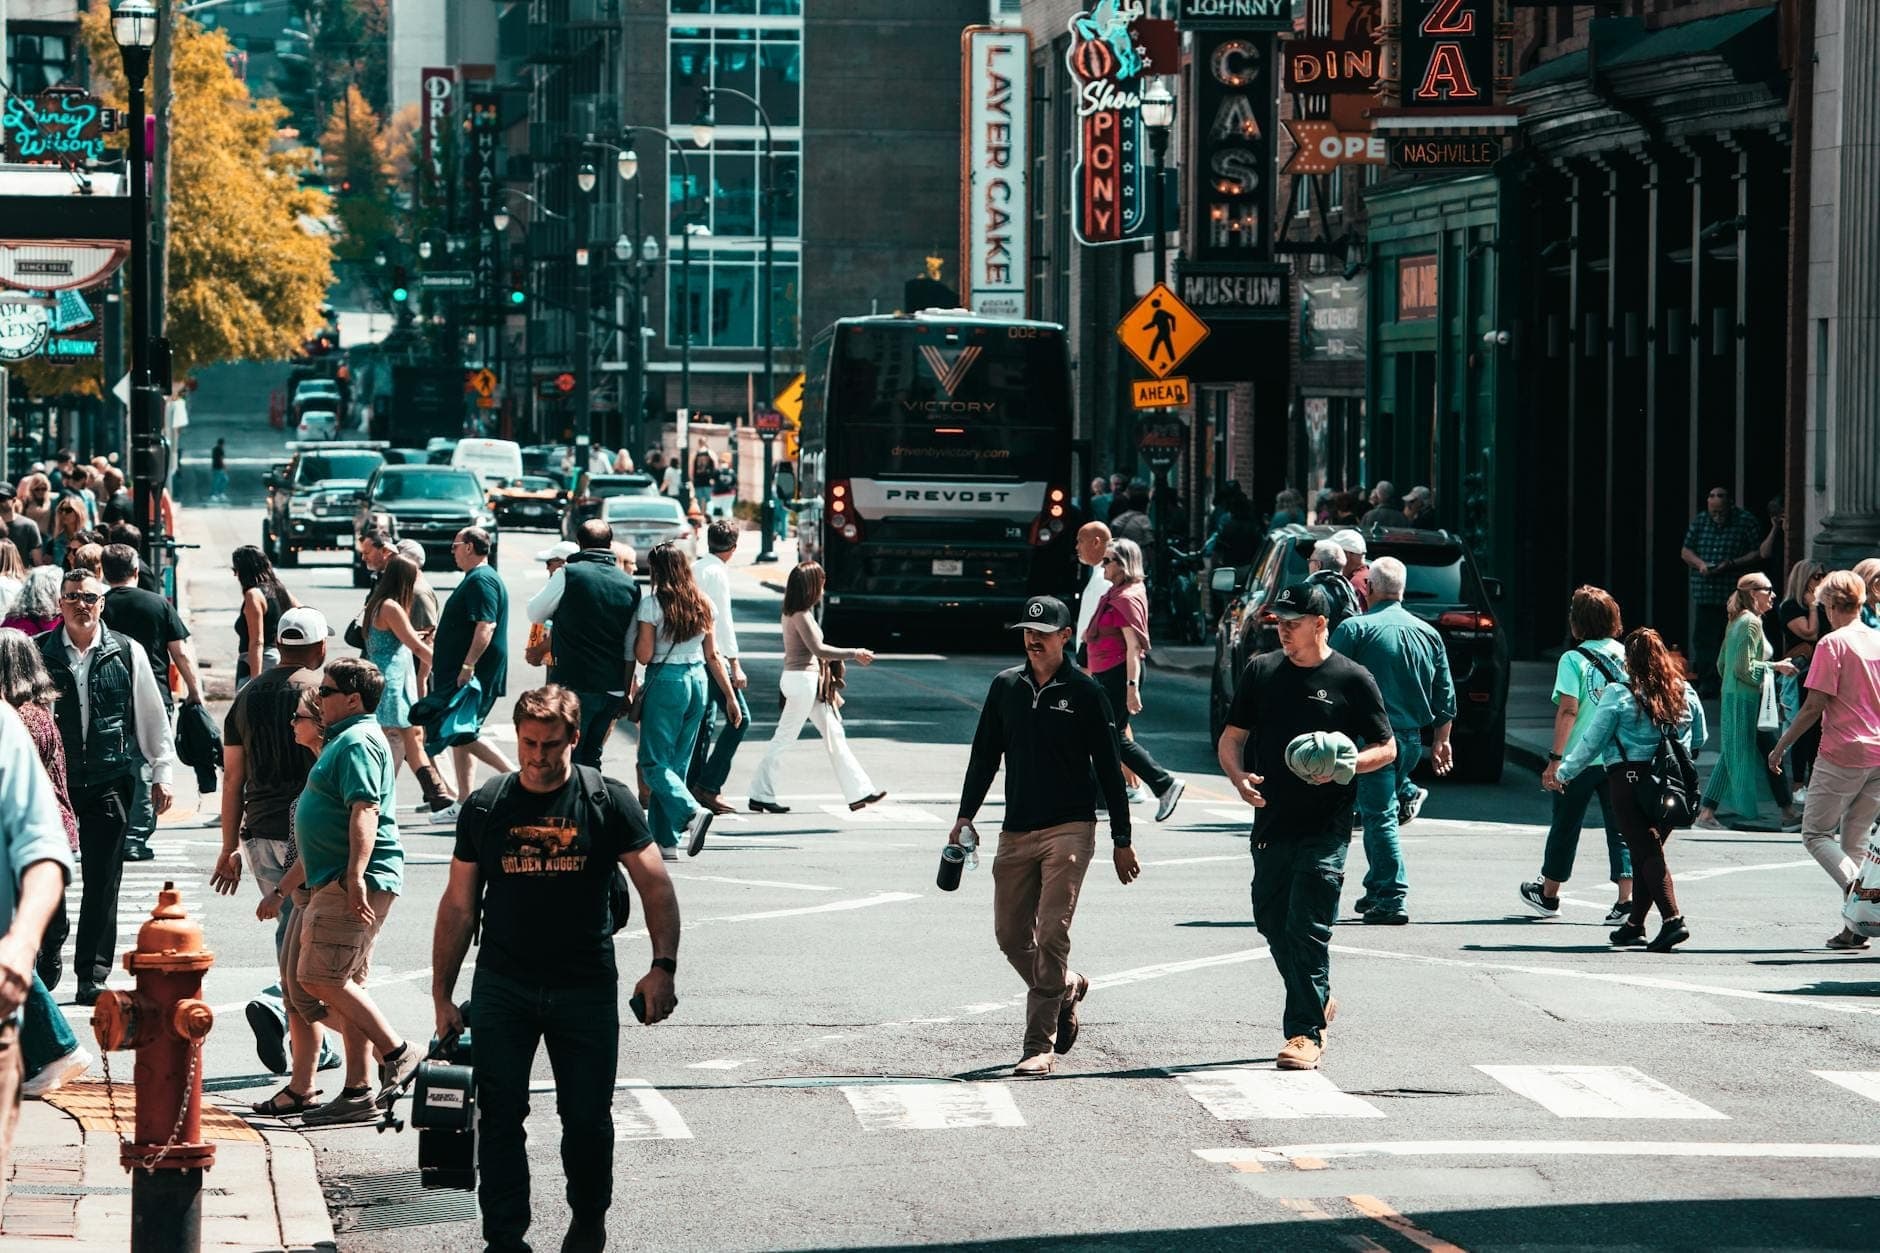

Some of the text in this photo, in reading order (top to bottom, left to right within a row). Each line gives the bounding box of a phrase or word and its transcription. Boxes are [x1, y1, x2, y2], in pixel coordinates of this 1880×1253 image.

[1186, 0, 1283, 16] JOHNNY
[1293, 50, 1384, 83] DIN
[1210, 39, 1261, 248] CASH
[1404, 143, 1490, 163] NASHVILLE
[479, 133, 492, 210] HYATT
[985, 45, 1012, 285] LAYER CAKE
[1092, 113, 1113, 233] PONY
[21, 263, 46, 271] SINCE
[1184, 276, 1281, 306] MUSEUM
[1008, 327, 1037, 338] 002
[1140, 385, 1185, 401] AHEAD
[904, 401, 996, 413] VICTORY
[891, 445, 1011, 460] drivenbyvictory.com
[886, 490, 1011, 503] PREVOST
[501, 855, 588, 873] GOLDEN NUGGET
